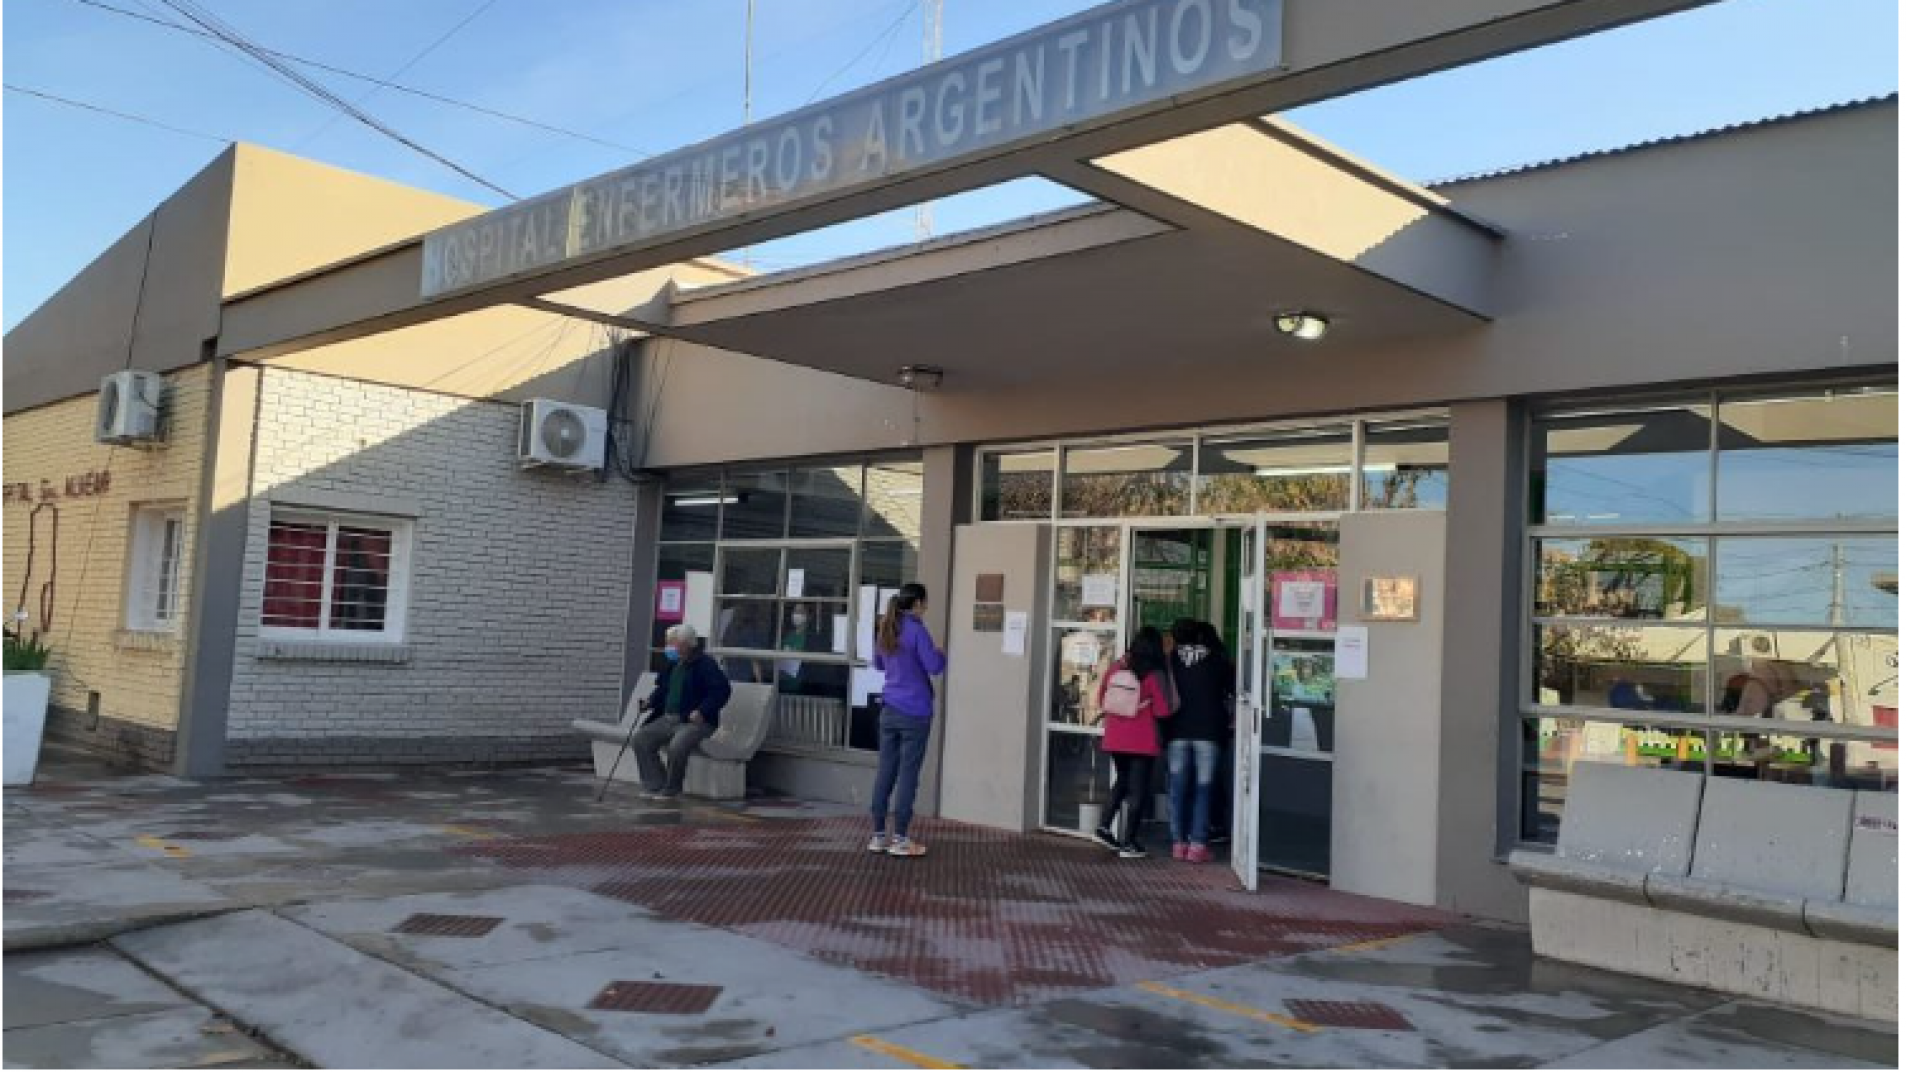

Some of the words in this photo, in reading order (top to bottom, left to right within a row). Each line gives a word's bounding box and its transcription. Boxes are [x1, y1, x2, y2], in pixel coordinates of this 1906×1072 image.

[427, 204, 557, 293] HOSPITAL
[568, 115, 833, 254] ENFERMEROS
[861, 0, 1263, 173] ARGENTINOS
